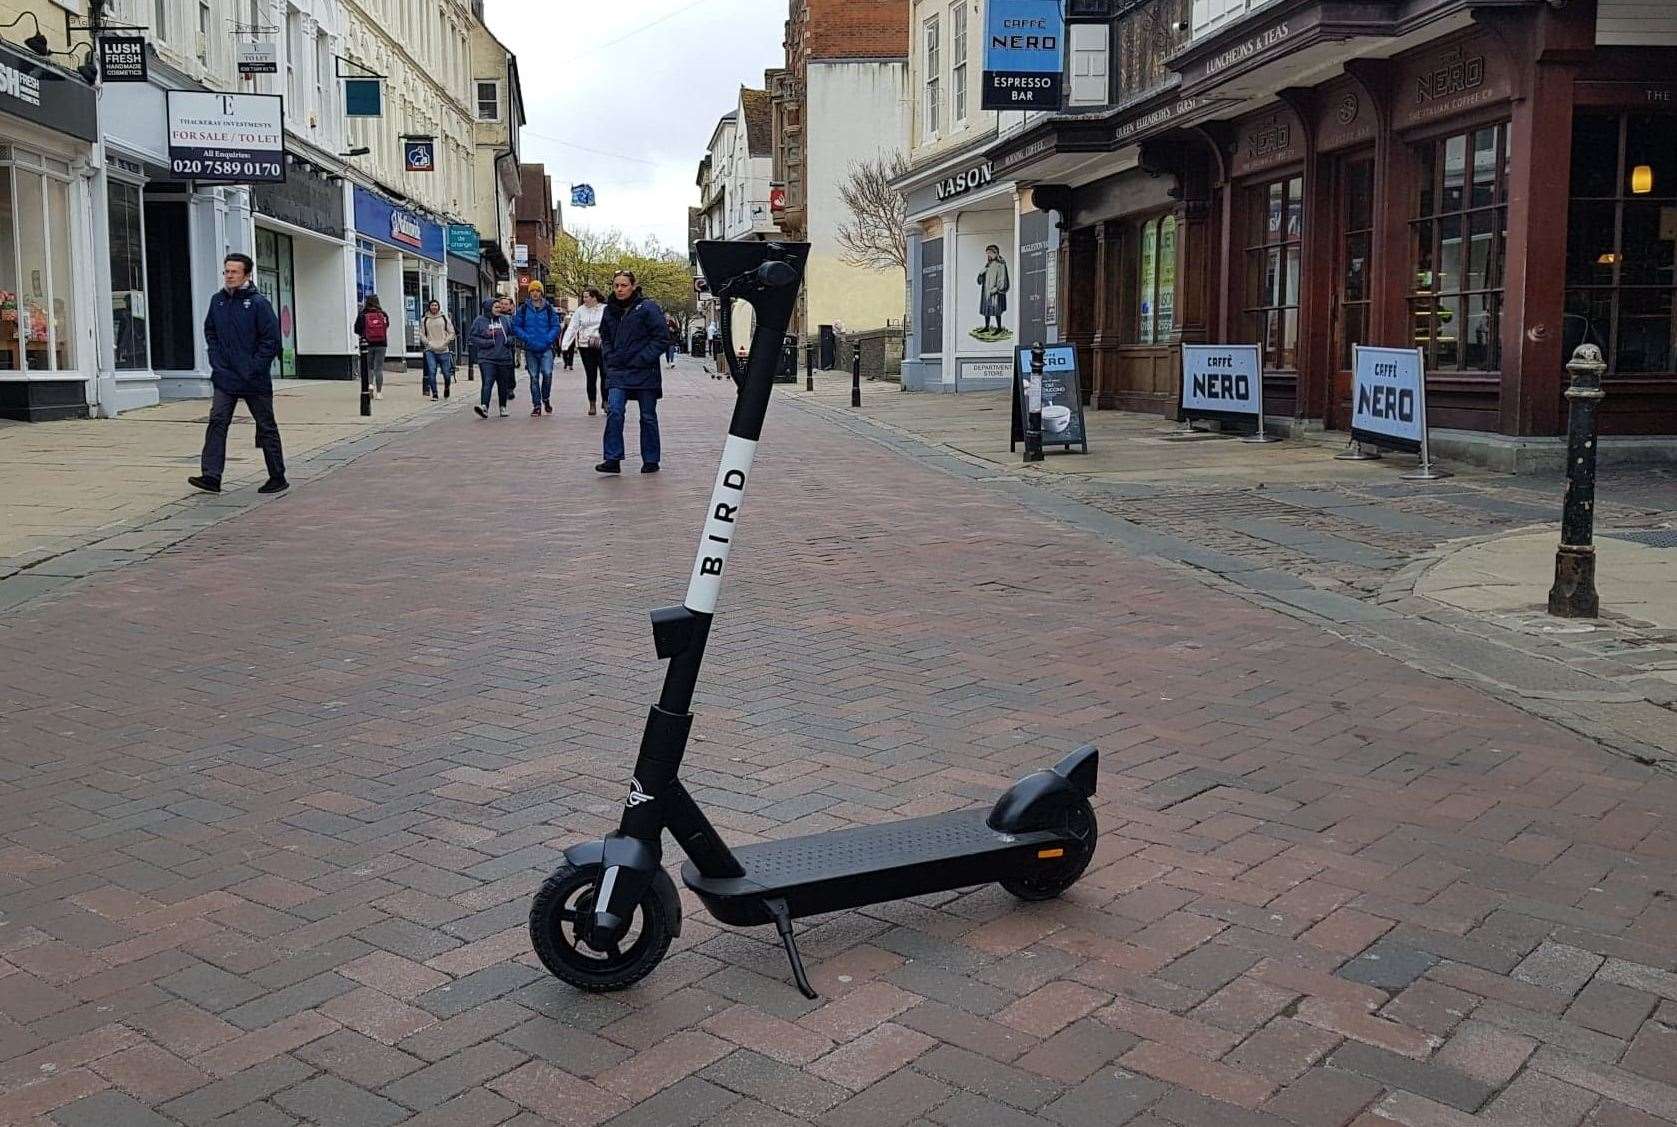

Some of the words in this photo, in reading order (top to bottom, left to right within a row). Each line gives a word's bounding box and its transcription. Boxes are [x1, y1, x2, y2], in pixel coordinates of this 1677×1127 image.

[104, 43, 141, 54] LUSH
[992, 35, 1056, 49] NERO
[1206, 42, 1254, 74] LUNCHEONS
[1256, 38, 1263, 50] &
[1264, 21, 1290, 46] TEAS
[105, 54, 142, 63] FRESH
[20, 73, 39, 91] FRESH
[994, 77, 1051, 88] ESPRESSO
[1416, 56, 1484, 104] NERO
[1011, 90, 1033, 101] BAR
[1176, 98, 1198, 116] GUEST
[173, 131, 198, 140] FOR
[199, 132, 229, 141] SALE
[239, 134, 255, 143] TO
[258, 135, 280, 144] LET
[173, 160, 202, 173] 020
[204, 161, 241, 175] 7589
[244, 162, 280, 176] 0170
[1207, 354, 1233, 368] CAFFÈ
[1374, 360, 1397, 378] CAFFÈ
[1193, 373, 1249, 401] NERO
[1358, 381, 1414, 423] NERO
[700, 469, 746, 576] BIRD
